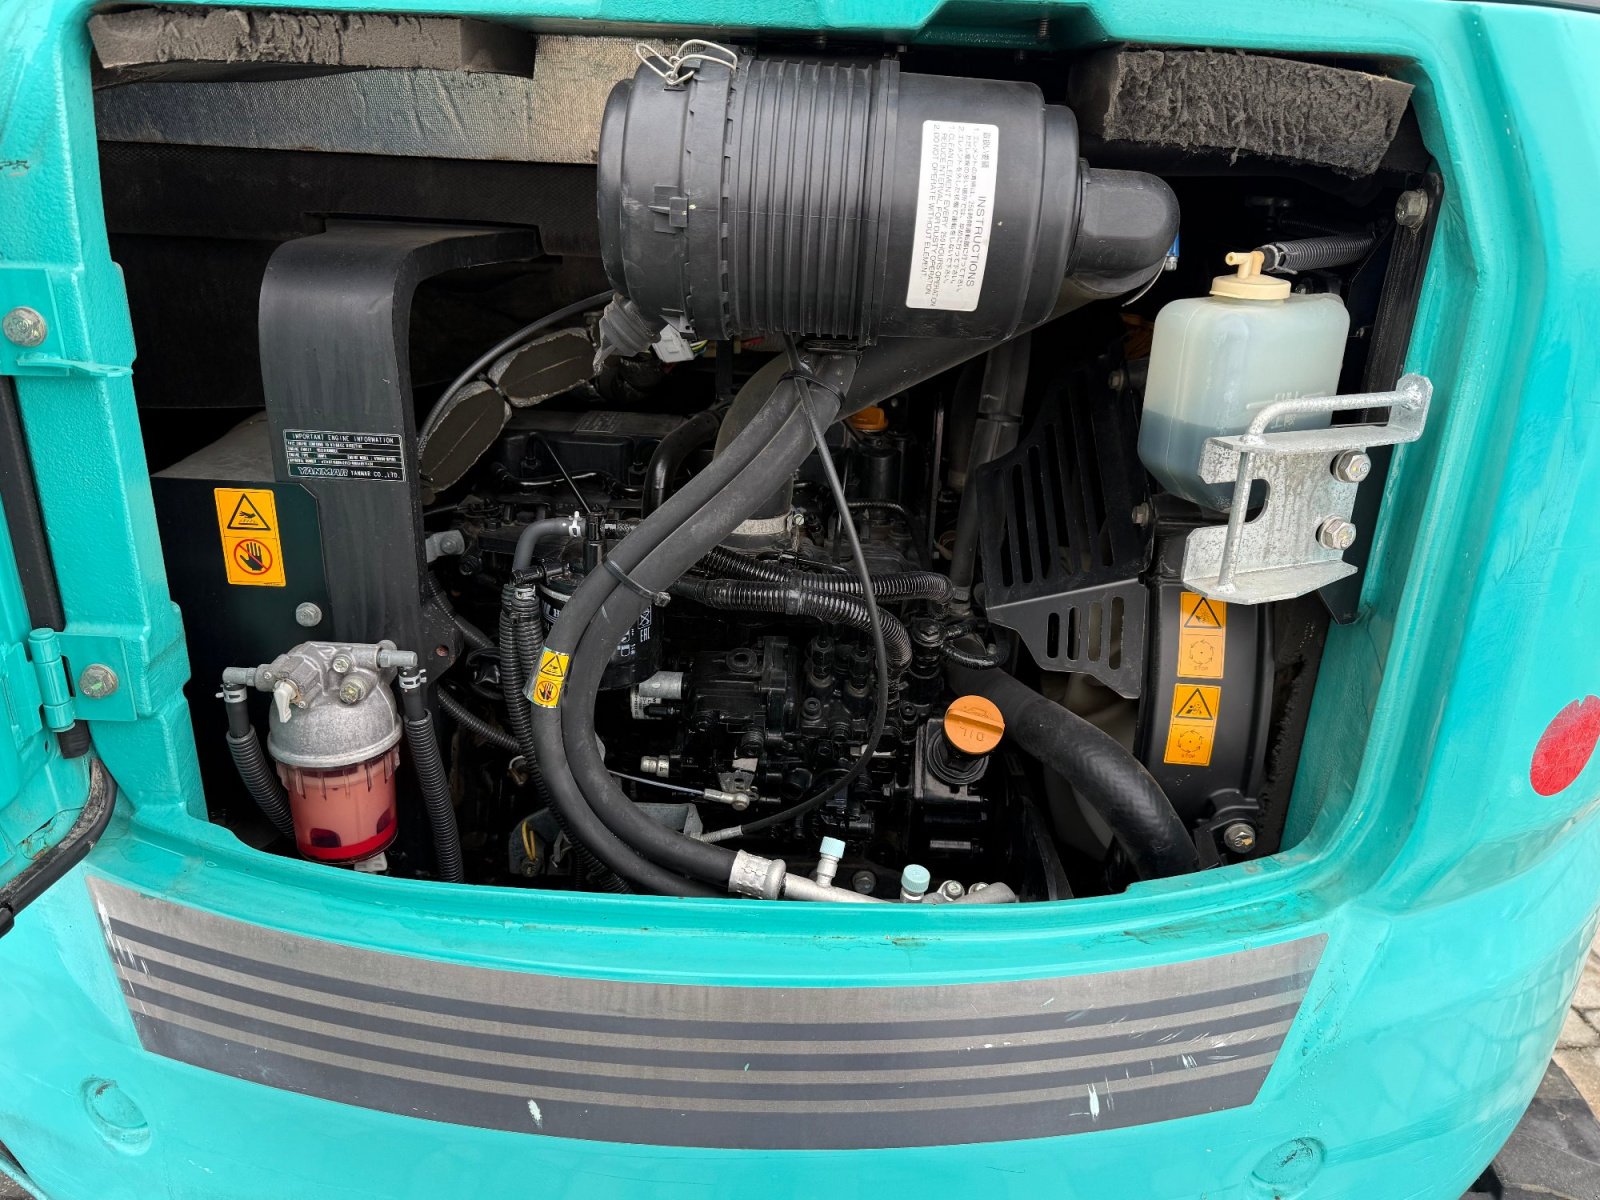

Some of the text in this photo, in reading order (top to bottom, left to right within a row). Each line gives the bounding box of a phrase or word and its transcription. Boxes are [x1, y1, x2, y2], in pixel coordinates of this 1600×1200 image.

[934, 132, 940, 142] DO
[929, 163, 938, 200] OPERATE
[937, 165, 945, 204] INTERVAL
[945, 160, 953, 198] ELEMENT
[926, 203, 935, 239] WITHOUT
[942, 200, 950, 227] EVERY
[931, 226, 940, 254] DUSTY
[966, 196, 986, 287] INSTRUCTIONS
[936, 244, 945, 269] HOURS
[298, 467, 348, 476] YANMAR
